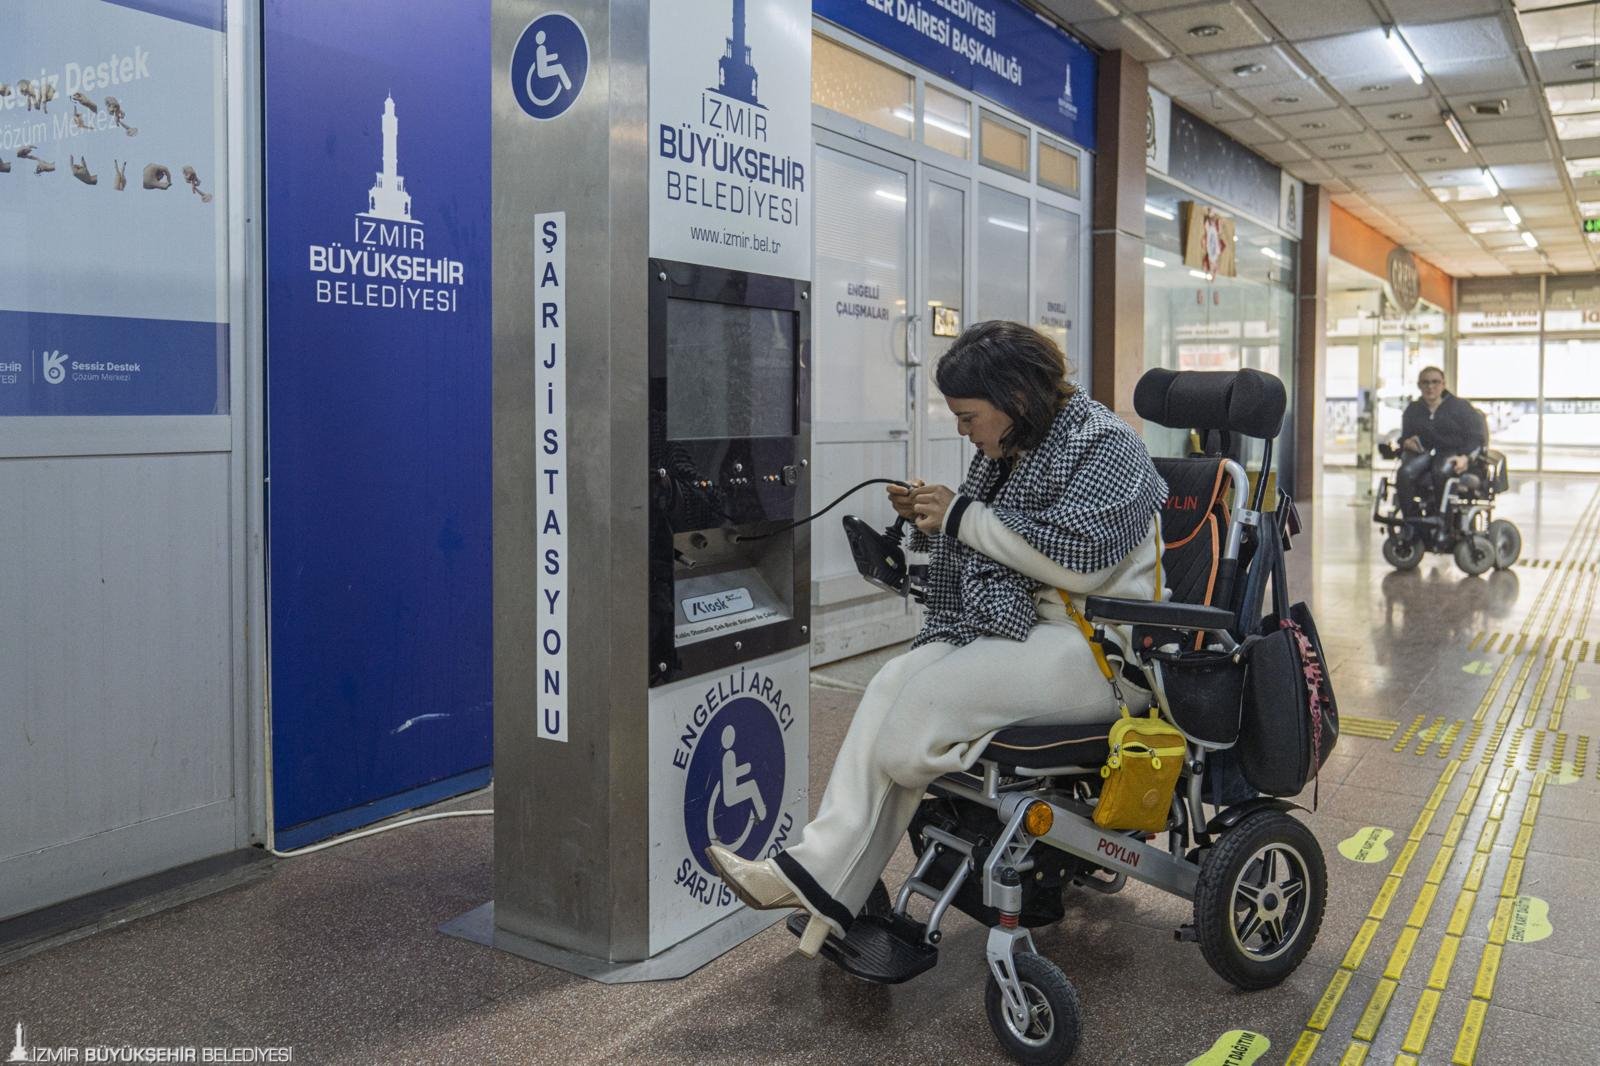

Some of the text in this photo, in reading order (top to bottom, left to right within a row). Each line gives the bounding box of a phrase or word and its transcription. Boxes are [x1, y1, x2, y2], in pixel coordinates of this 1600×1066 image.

[897, 0, 950, 47] DAİRESİ
[952, 27, 1022, 86] BAŞKANLIĞI
[65, 46, 150, 97] Destek
[702, 92, 767, 142] İZMİR
[0, 120, 47, 150] özüm
[659, 122, 804, 192] BÜYÜKŞEHİR
[667, 170, 798, 226] BELEDİYESİ
[355, 217, 424, 250] İZMİR
[690, 225, 781, 254] www.izmir.bel.tr
[309, 241, 464, 285] BÜYÜKŞEHİR
[316, 279, 457, 312] BELEDİYESİ
[836, 301, 889, 321] ÇALIŞMALARI
[0, 361, 22, 372] EHİR
[71, 361, 141, 372] Sessiz Destek
[1166, 495, 1198, 511] YLIN
[692, 597, 729, 617] Kiosk
[672, 666, 795, 770] ENGELLİ ARACI
[1097, 837, 1141, 868] POYLIN
[674, 858, 716, 905] ŞARJ
